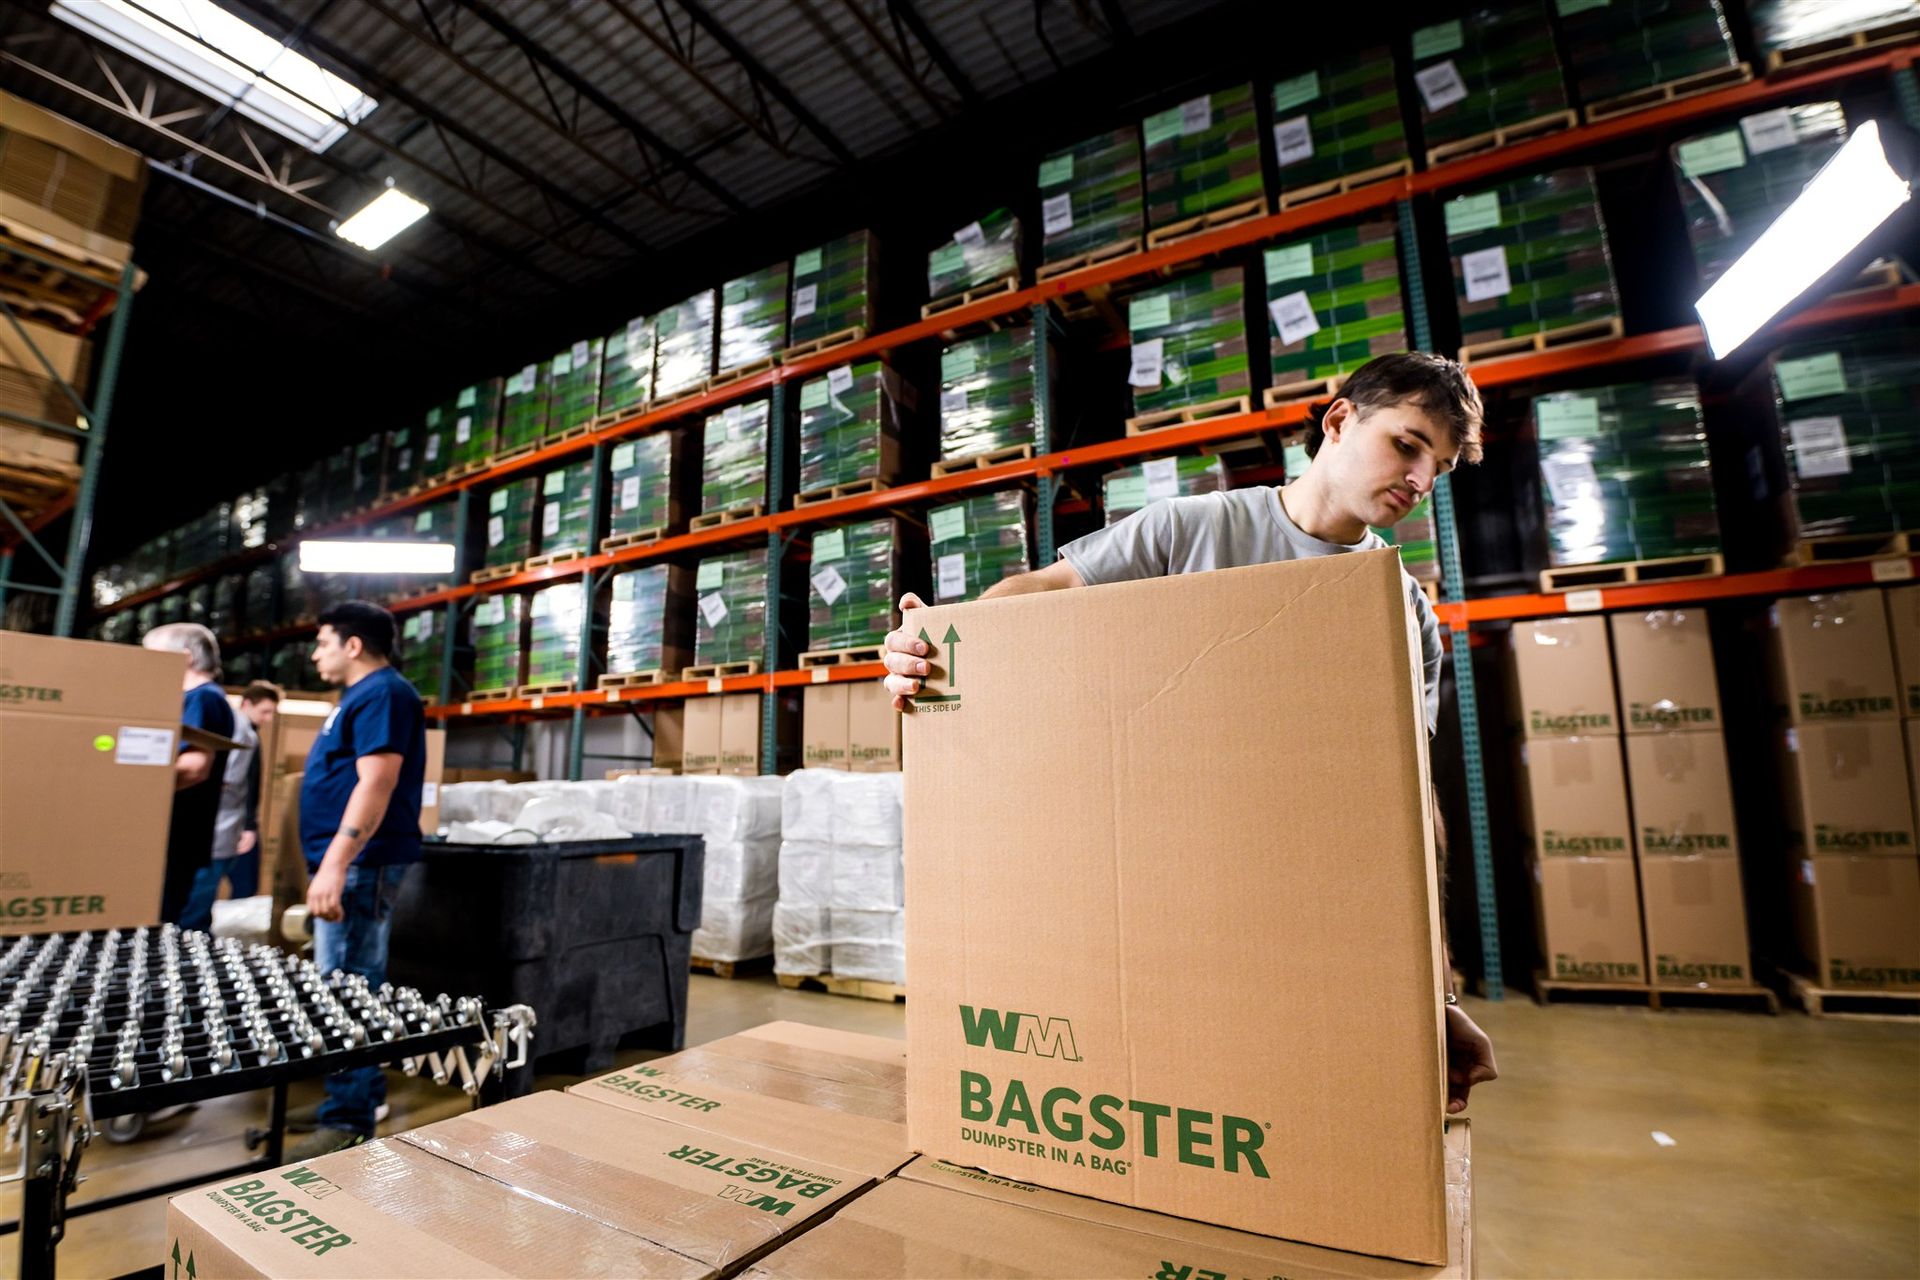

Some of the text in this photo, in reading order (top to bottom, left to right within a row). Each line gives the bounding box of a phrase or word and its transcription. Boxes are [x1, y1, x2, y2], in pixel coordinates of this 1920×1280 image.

[914, 703, 962, 713] THIS SIDE UP
[961, 1127, 1046, 1159] DUMPSTER
[1051, 1146, 1068, 1164] IN
[1073, 1152, 1086, 1168] A
[280, 1166, 342, 1200] WM
[789, 1168, 843, 1185] DUMPSTER
[930, 1162, 986, 1182] DUMPSTER
[987, 1177, 1001, 1185] IN
[206, 1191, 241, 1215] DUMPSTER
[717, 1184, 796, 1217] WM
